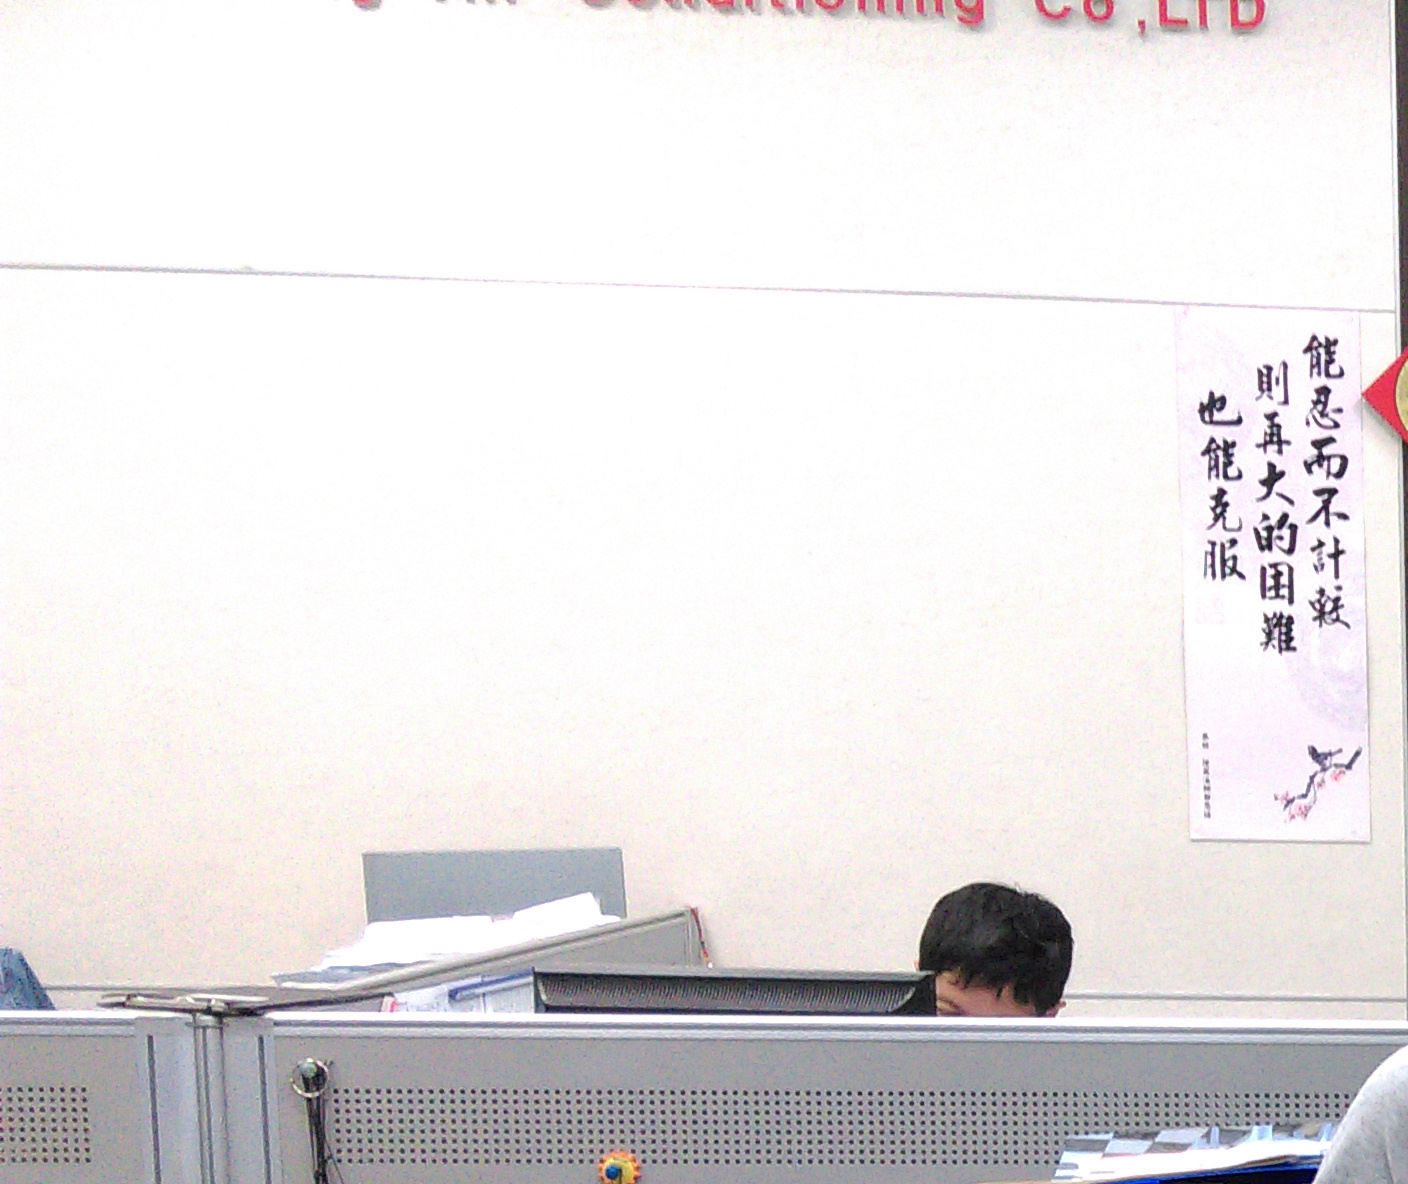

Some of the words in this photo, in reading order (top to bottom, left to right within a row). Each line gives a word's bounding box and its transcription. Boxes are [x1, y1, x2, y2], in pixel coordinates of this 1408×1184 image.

[1197, 389, 1247, 582] 也能克服
[1252, 360, 1299, 656] 則再大的困難
[1302, 333, 1352, 631] 能忍而不計較
